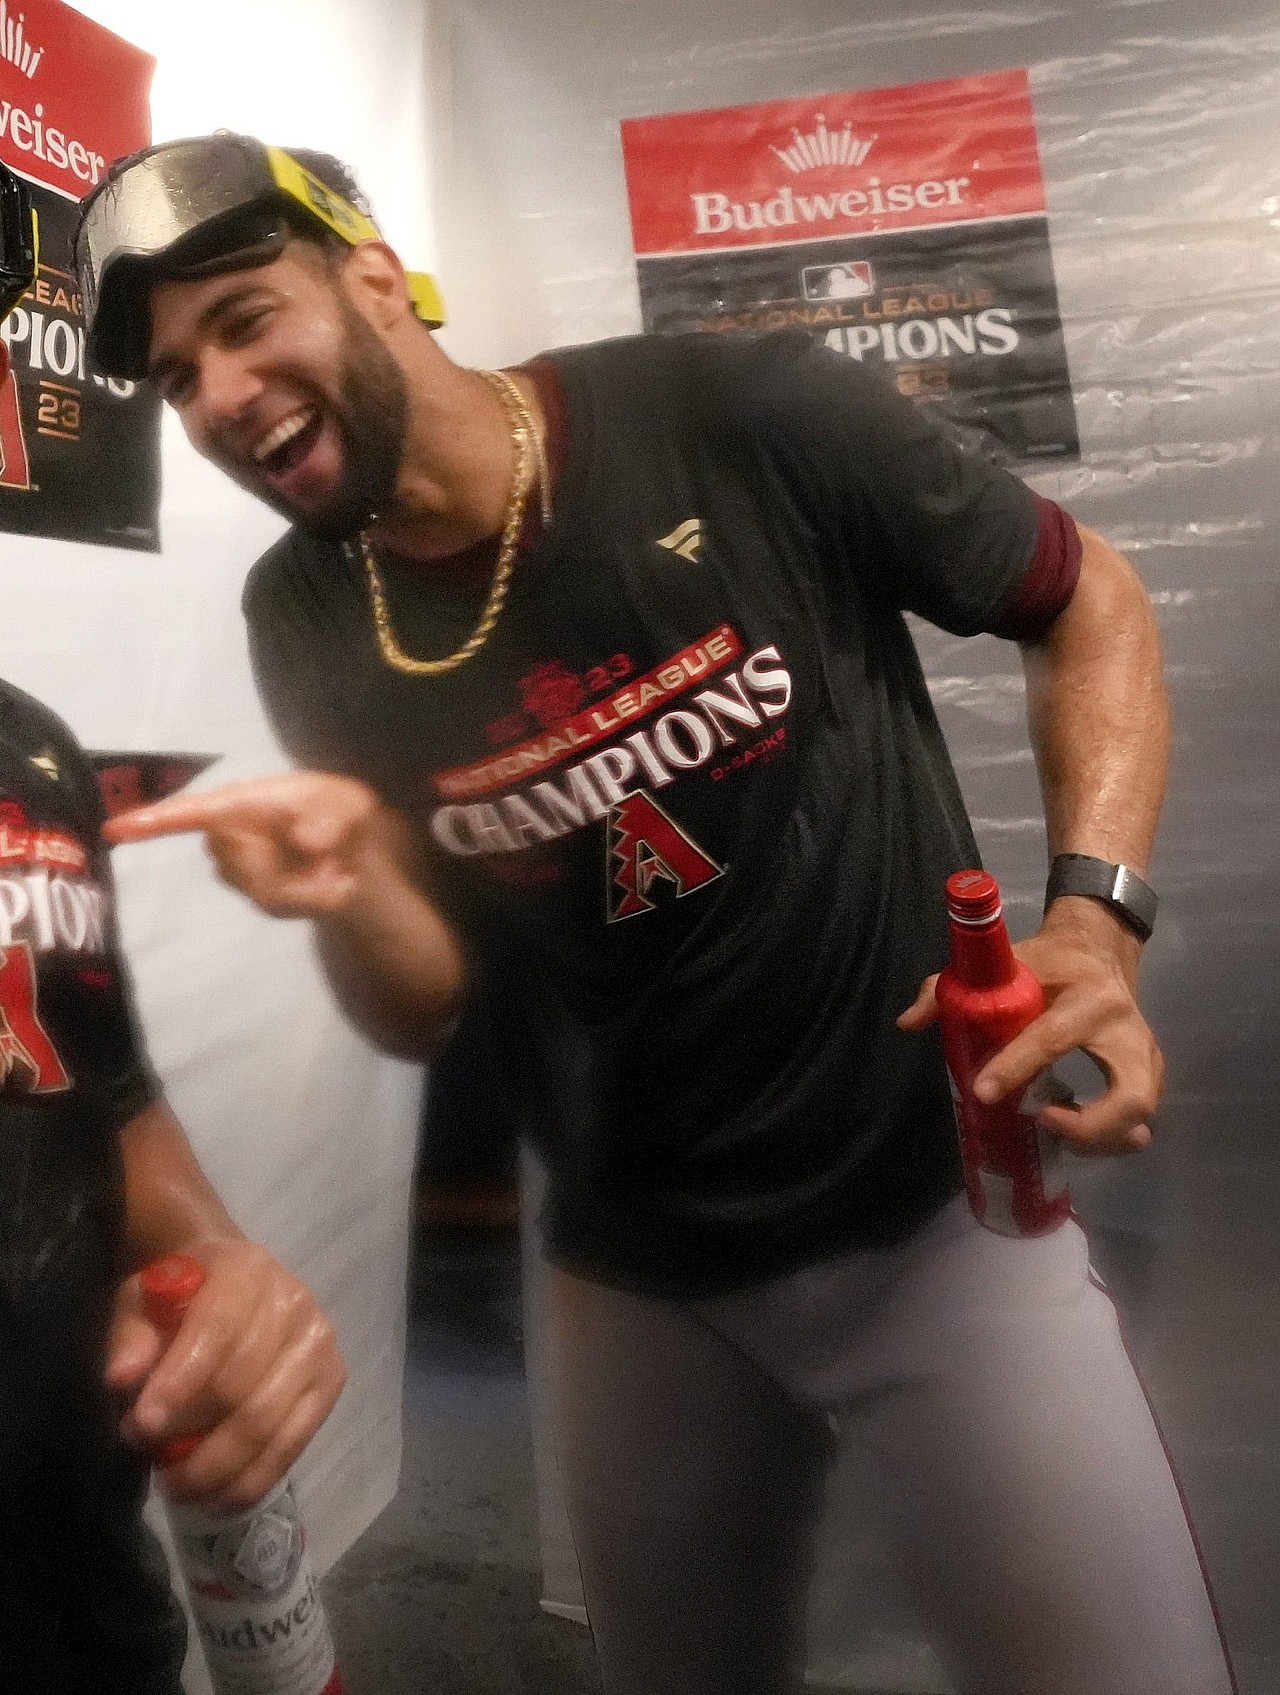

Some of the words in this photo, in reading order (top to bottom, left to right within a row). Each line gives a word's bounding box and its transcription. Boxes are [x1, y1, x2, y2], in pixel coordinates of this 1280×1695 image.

[690, 174, 970, 235] Budweiser
[862, 288, 993, 319] LEAGUE
[824, 308, 1020, 362] PIONS
[37, 393, 83, 430] 23
[591, 633, 733, 731] LEAGUE
[431, 645, 792, 856] CHAMPIONS
